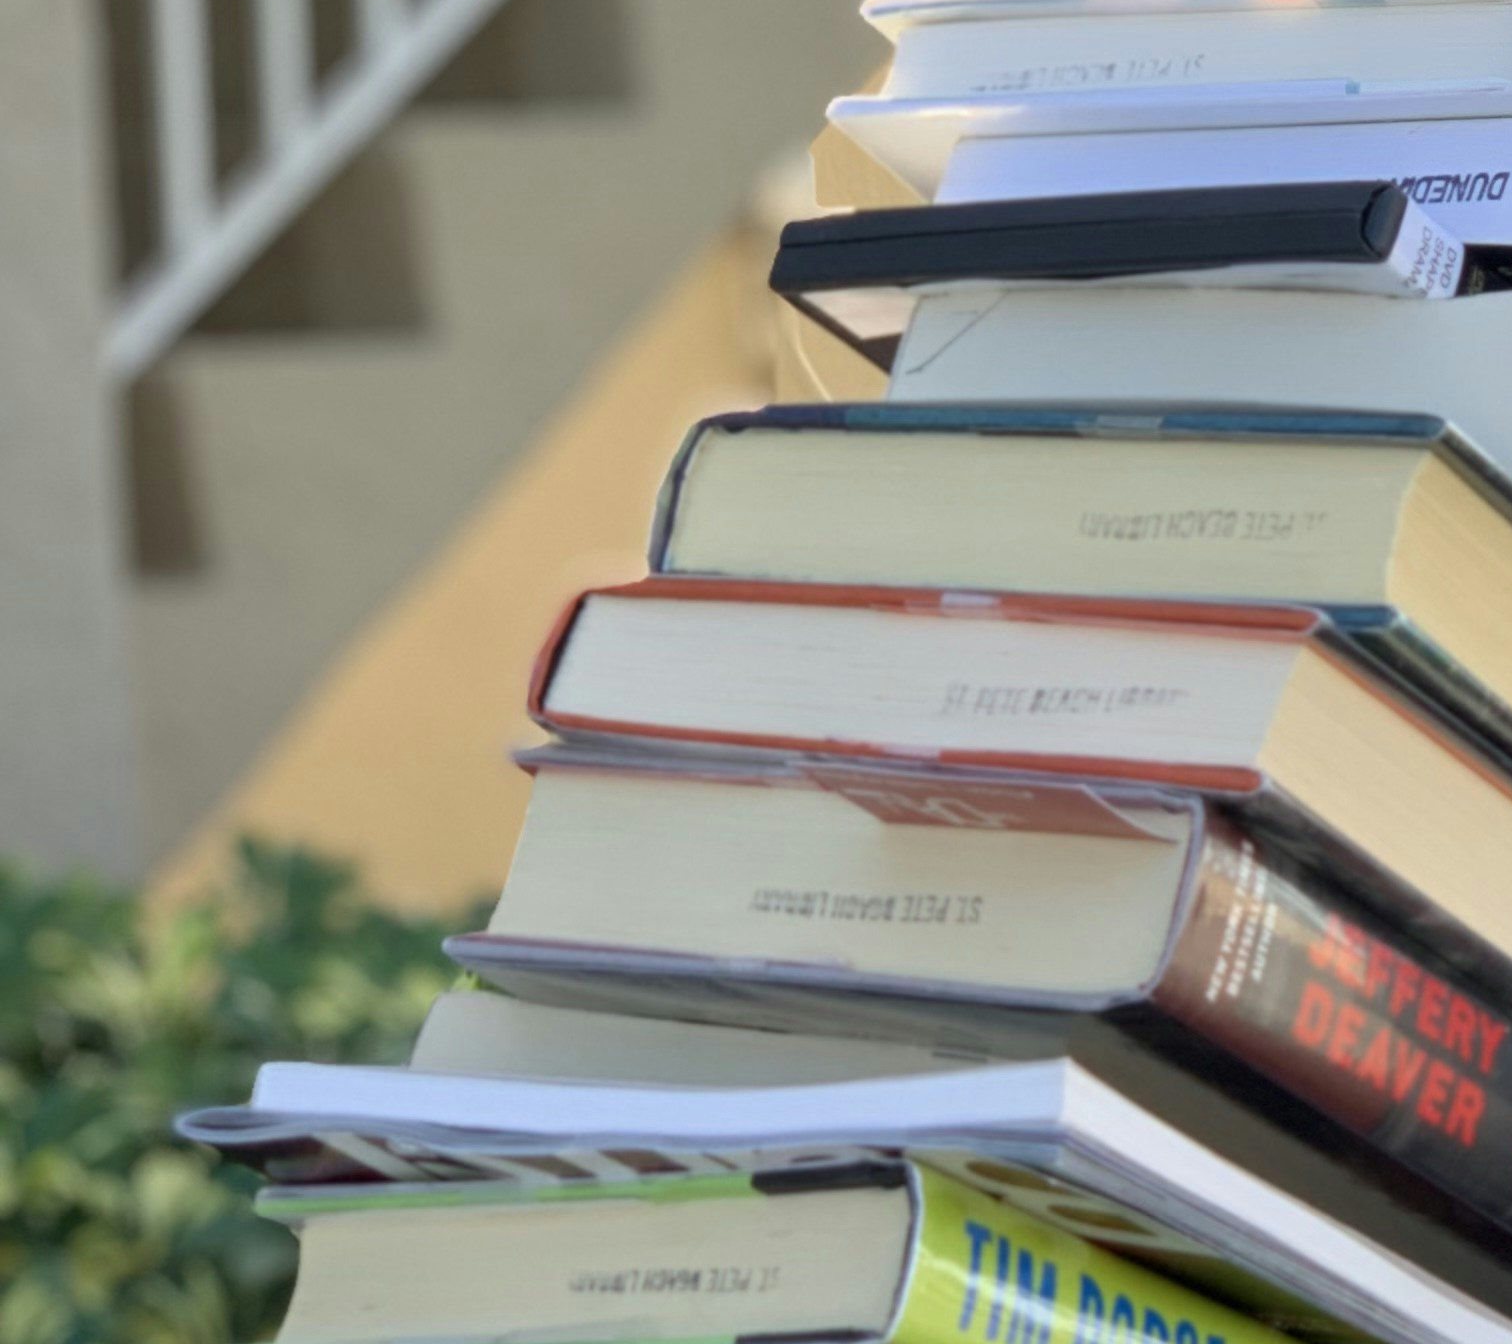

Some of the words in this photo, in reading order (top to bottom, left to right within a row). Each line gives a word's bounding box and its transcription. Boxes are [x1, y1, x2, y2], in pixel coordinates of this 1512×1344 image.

[1439, 246, 1458, 289] DVD
[1291, 980, 1486, 1149] DEAVER
[1307, 910, 1511, 1077] JEFFERY
